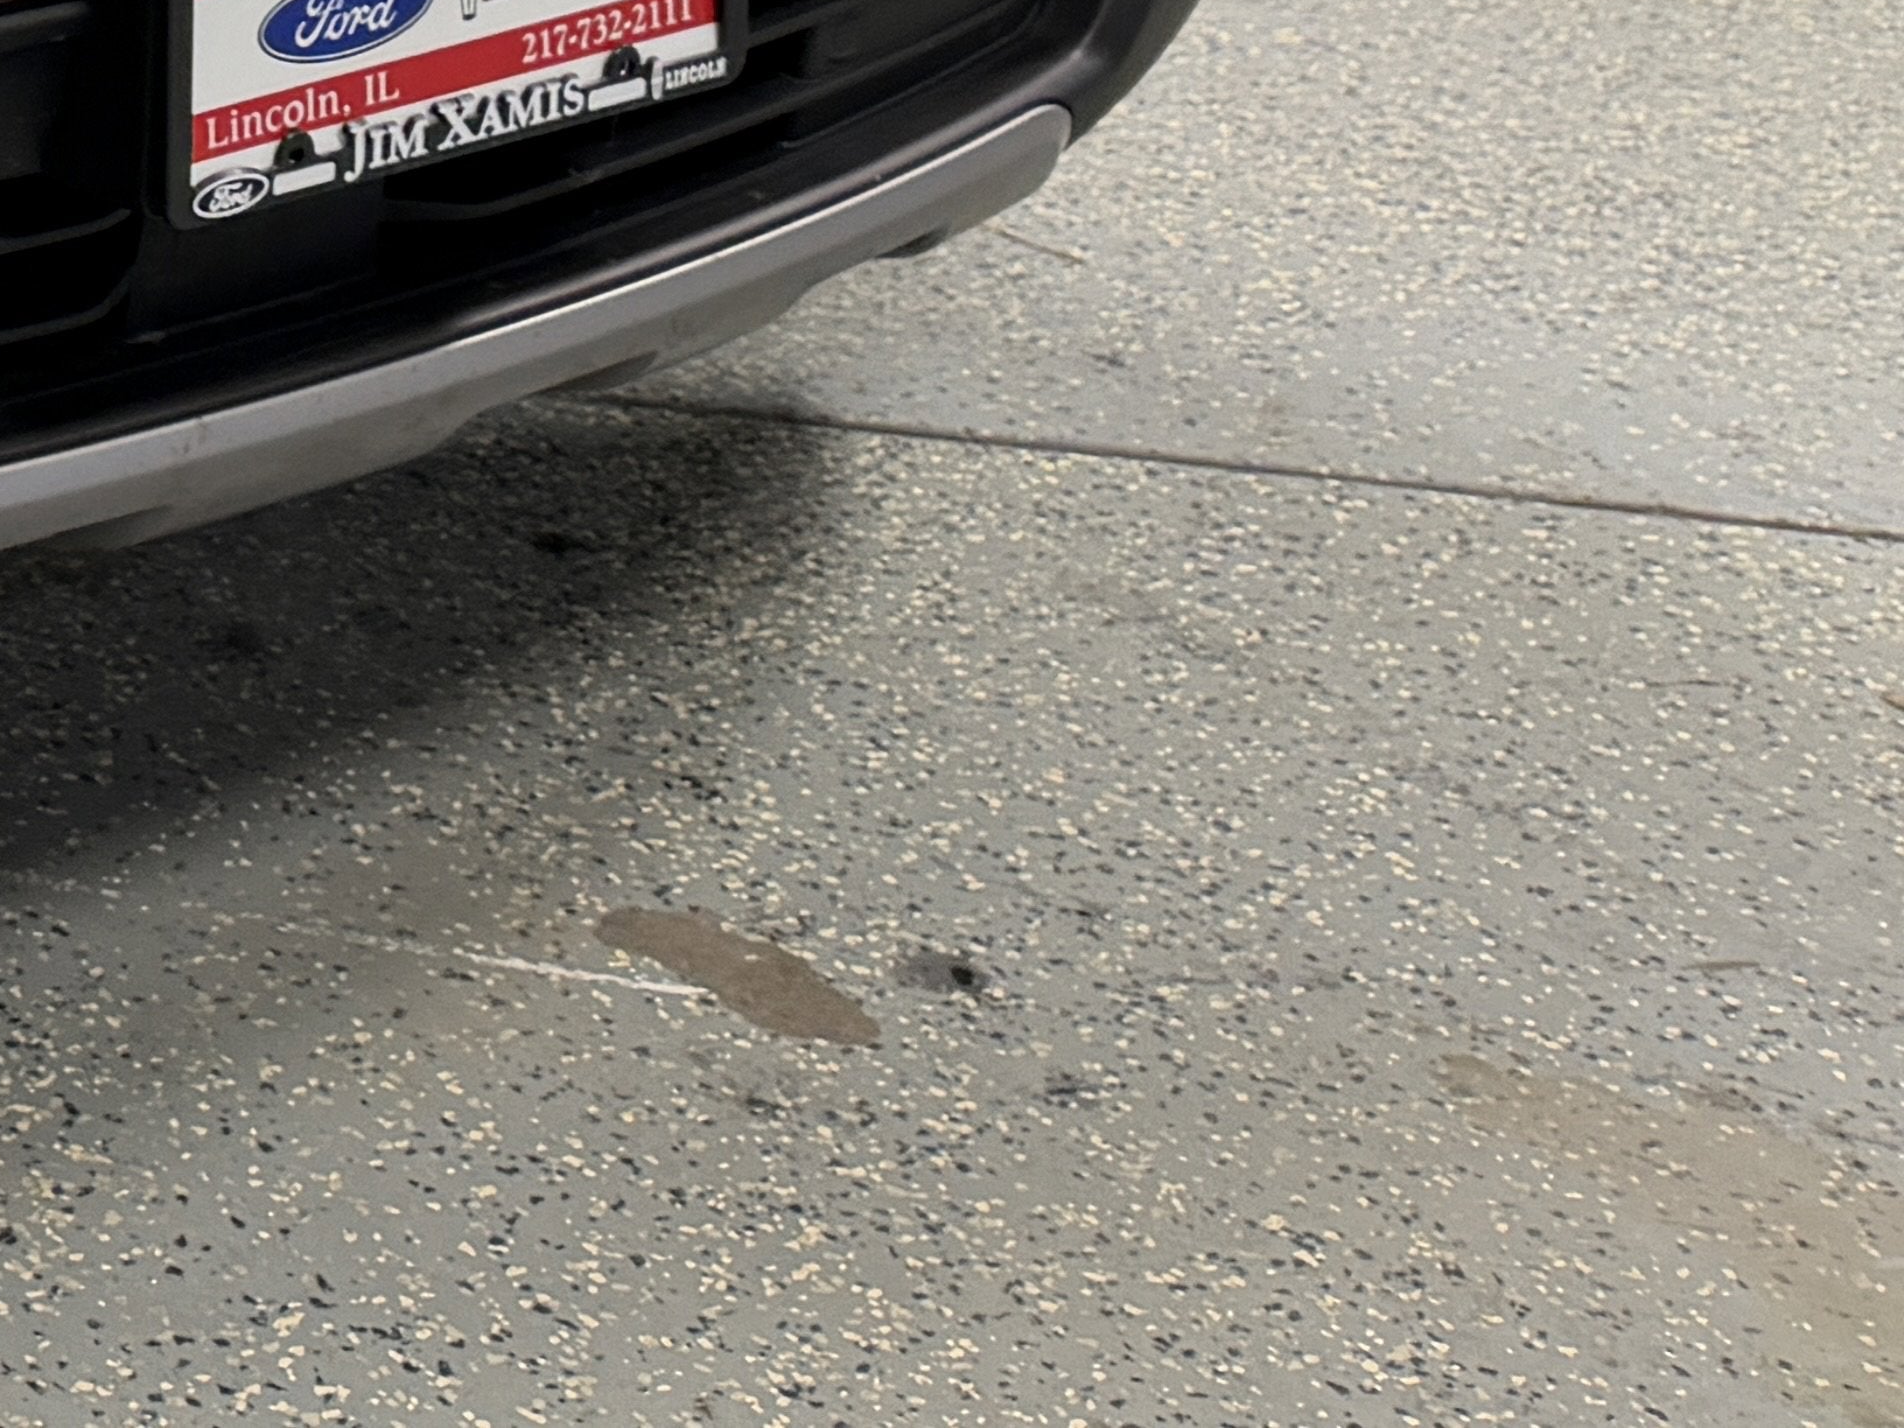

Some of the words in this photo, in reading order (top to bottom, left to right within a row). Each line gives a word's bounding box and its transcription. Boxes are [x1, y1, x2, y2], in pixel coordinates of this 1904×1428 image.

[206, 87, 352, 150] Lincoln,
[364, 71, 400, 106] IL
[664, 55, 728, 90] LINCOLN
[344, 119, 429, 182] JIM
[437, 77, 584, 151] XAMIS
